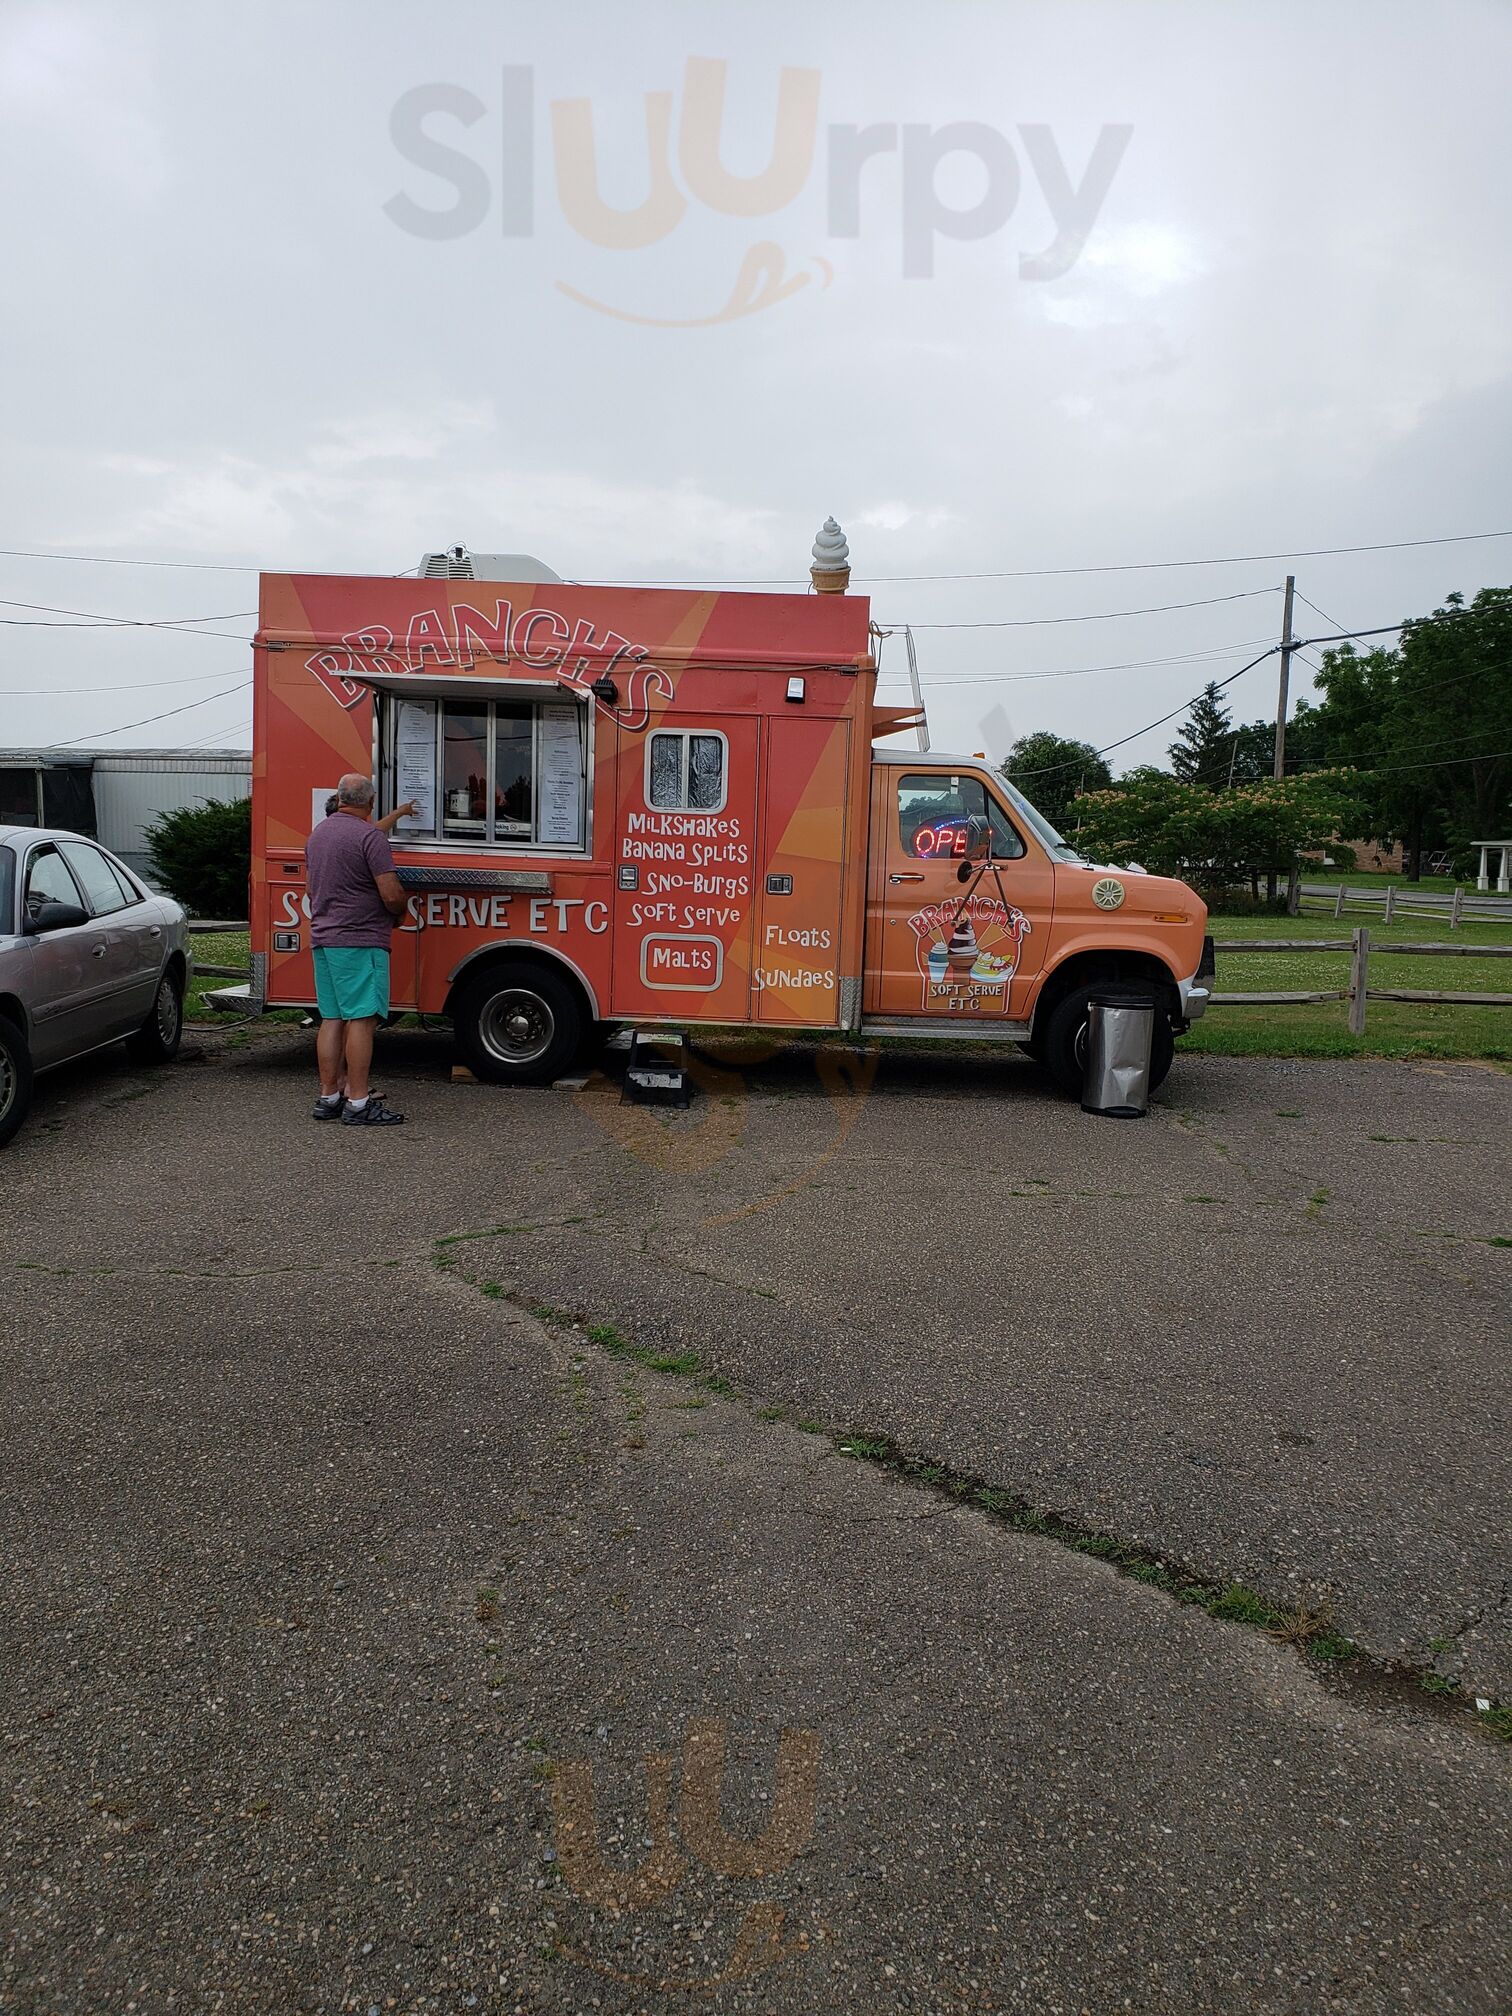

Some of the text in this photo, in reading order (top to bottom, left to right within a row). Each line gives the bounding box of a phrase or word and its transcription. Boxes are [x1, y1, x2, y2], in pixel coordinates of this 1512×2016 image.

[304, 599, 675, 730] BRANCH'S
[916, 829, 967, 854] OPE
[399, 893, 608, 933] SERVE ETC
[928, 984, 1004, 998] SOFT SERVE
[949, 997, 980, 1010] ETC
